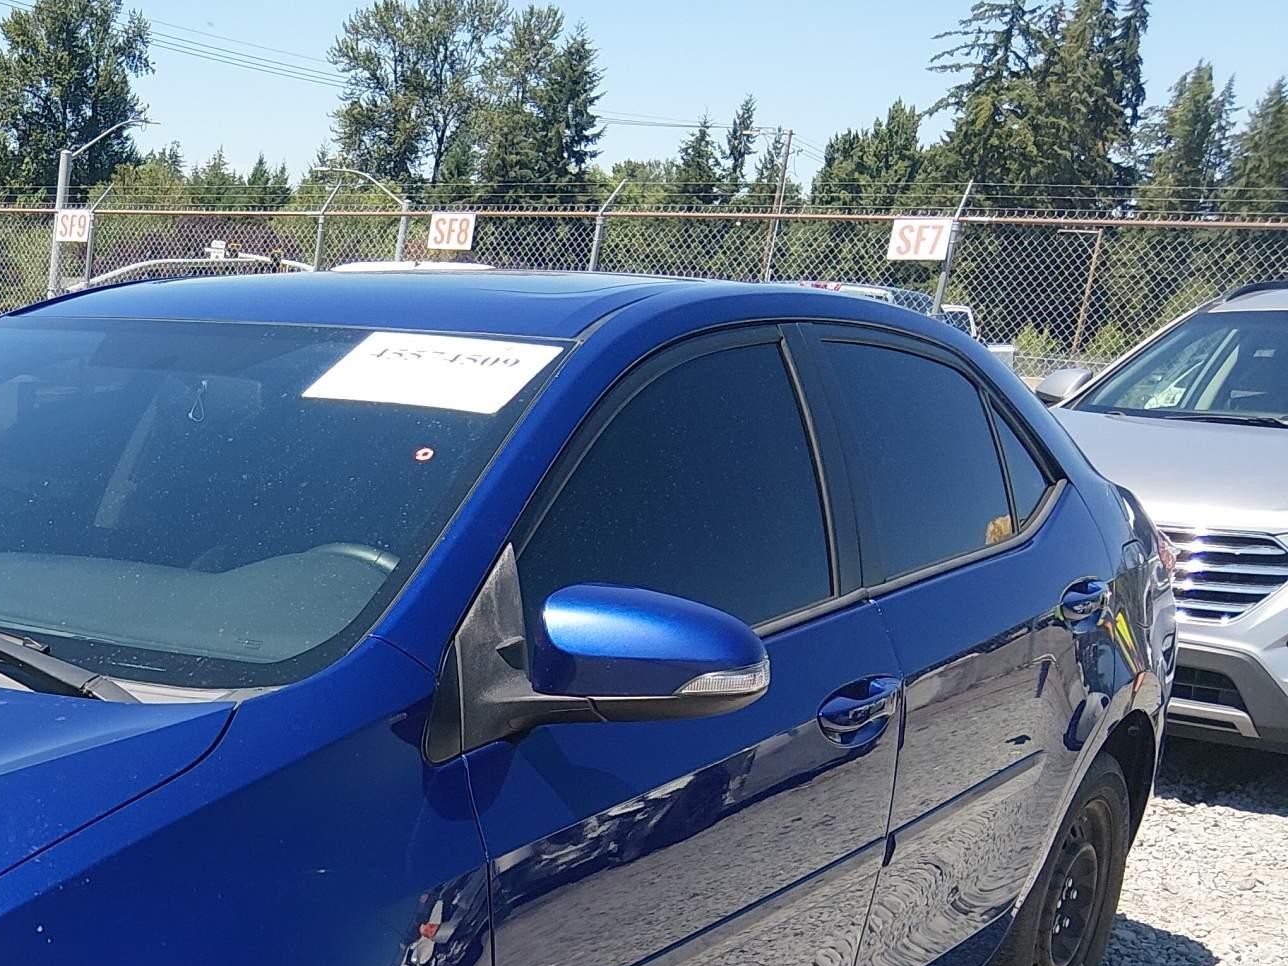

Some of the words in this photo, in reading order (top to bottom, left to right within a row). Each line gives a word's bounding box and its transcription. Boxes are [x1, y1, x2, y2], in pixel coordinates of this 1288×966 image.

[59, 214, 87, 238] SF9
[433, 218, 470, 245] SF8
[895, 224, 944, 255] SF7
